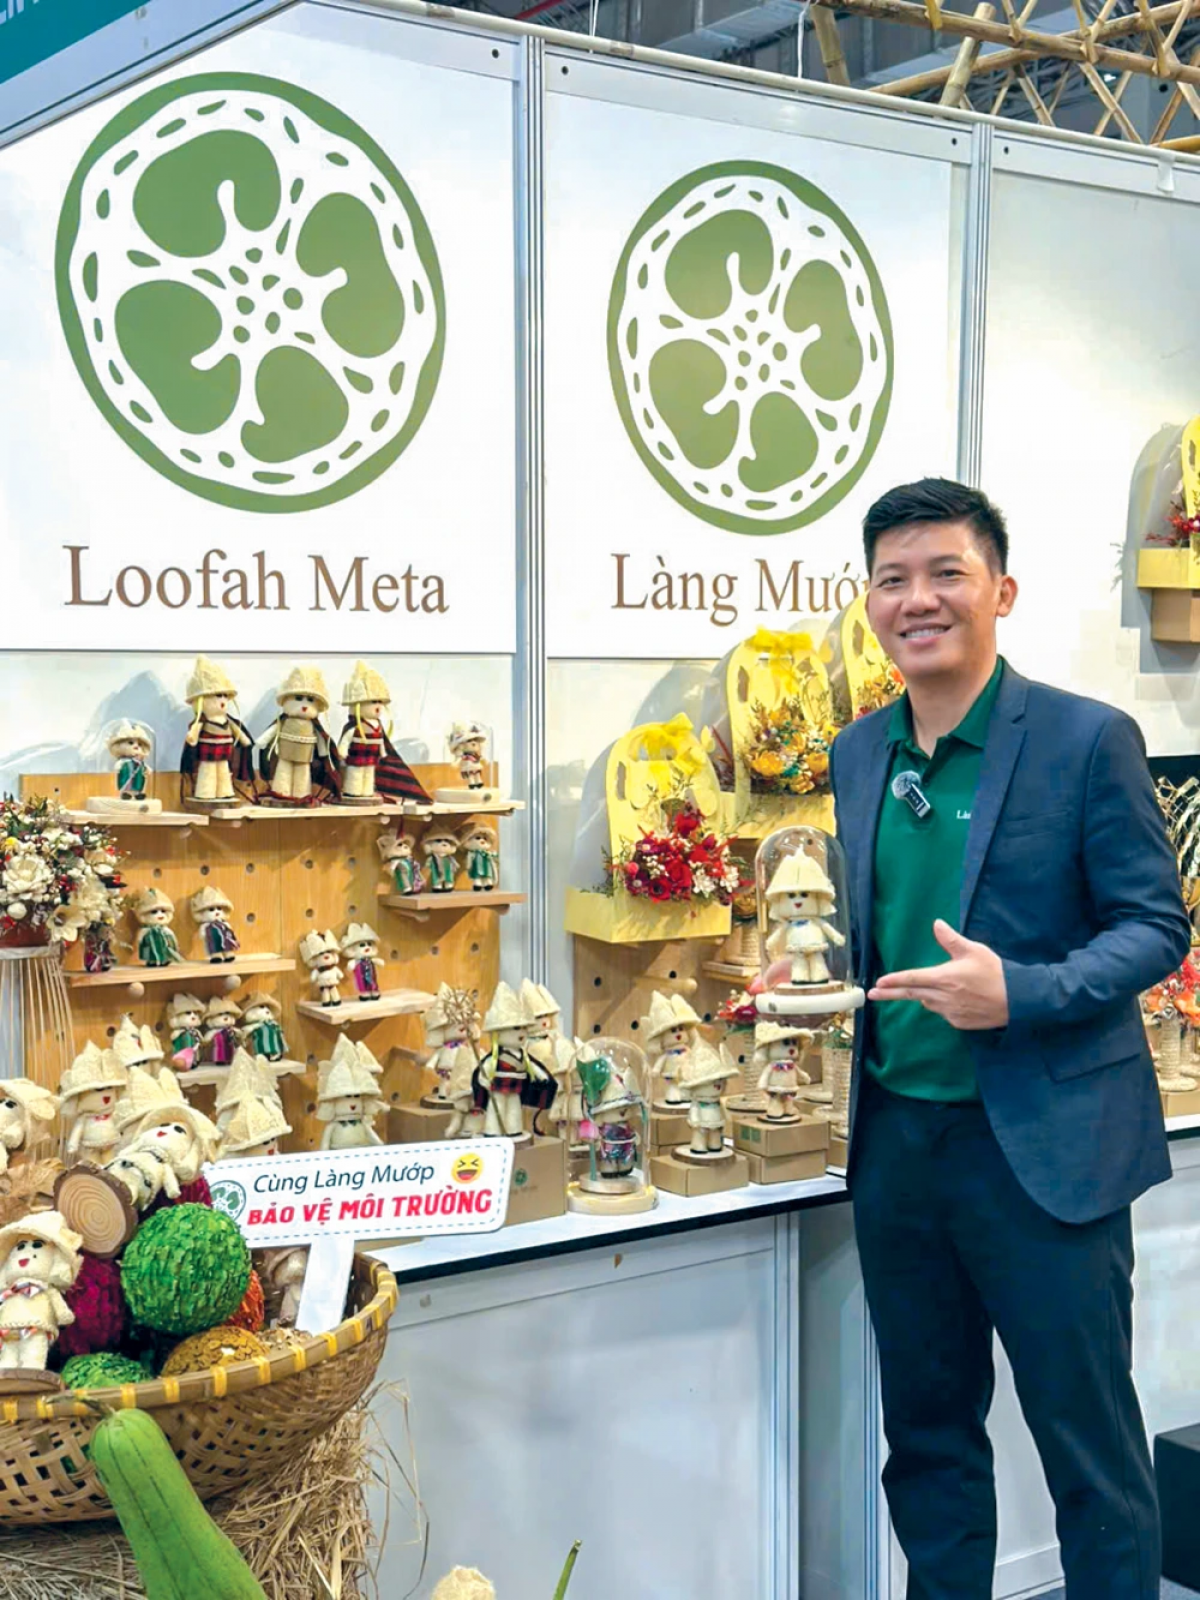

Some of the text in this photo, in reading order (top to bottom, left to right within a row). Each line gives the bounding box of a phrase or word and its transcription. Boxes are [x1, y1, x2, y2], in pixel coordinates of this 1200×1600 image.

[62, 545, 450, 614] Loofah Meta
[610, 553, 870, 627] Làng Mướ
[247, 1184, 492, 1226] BẢO VỆ MÔI TRƯỜNG
[253, 1161, 434, 1195] Cùng Làng Mướp
